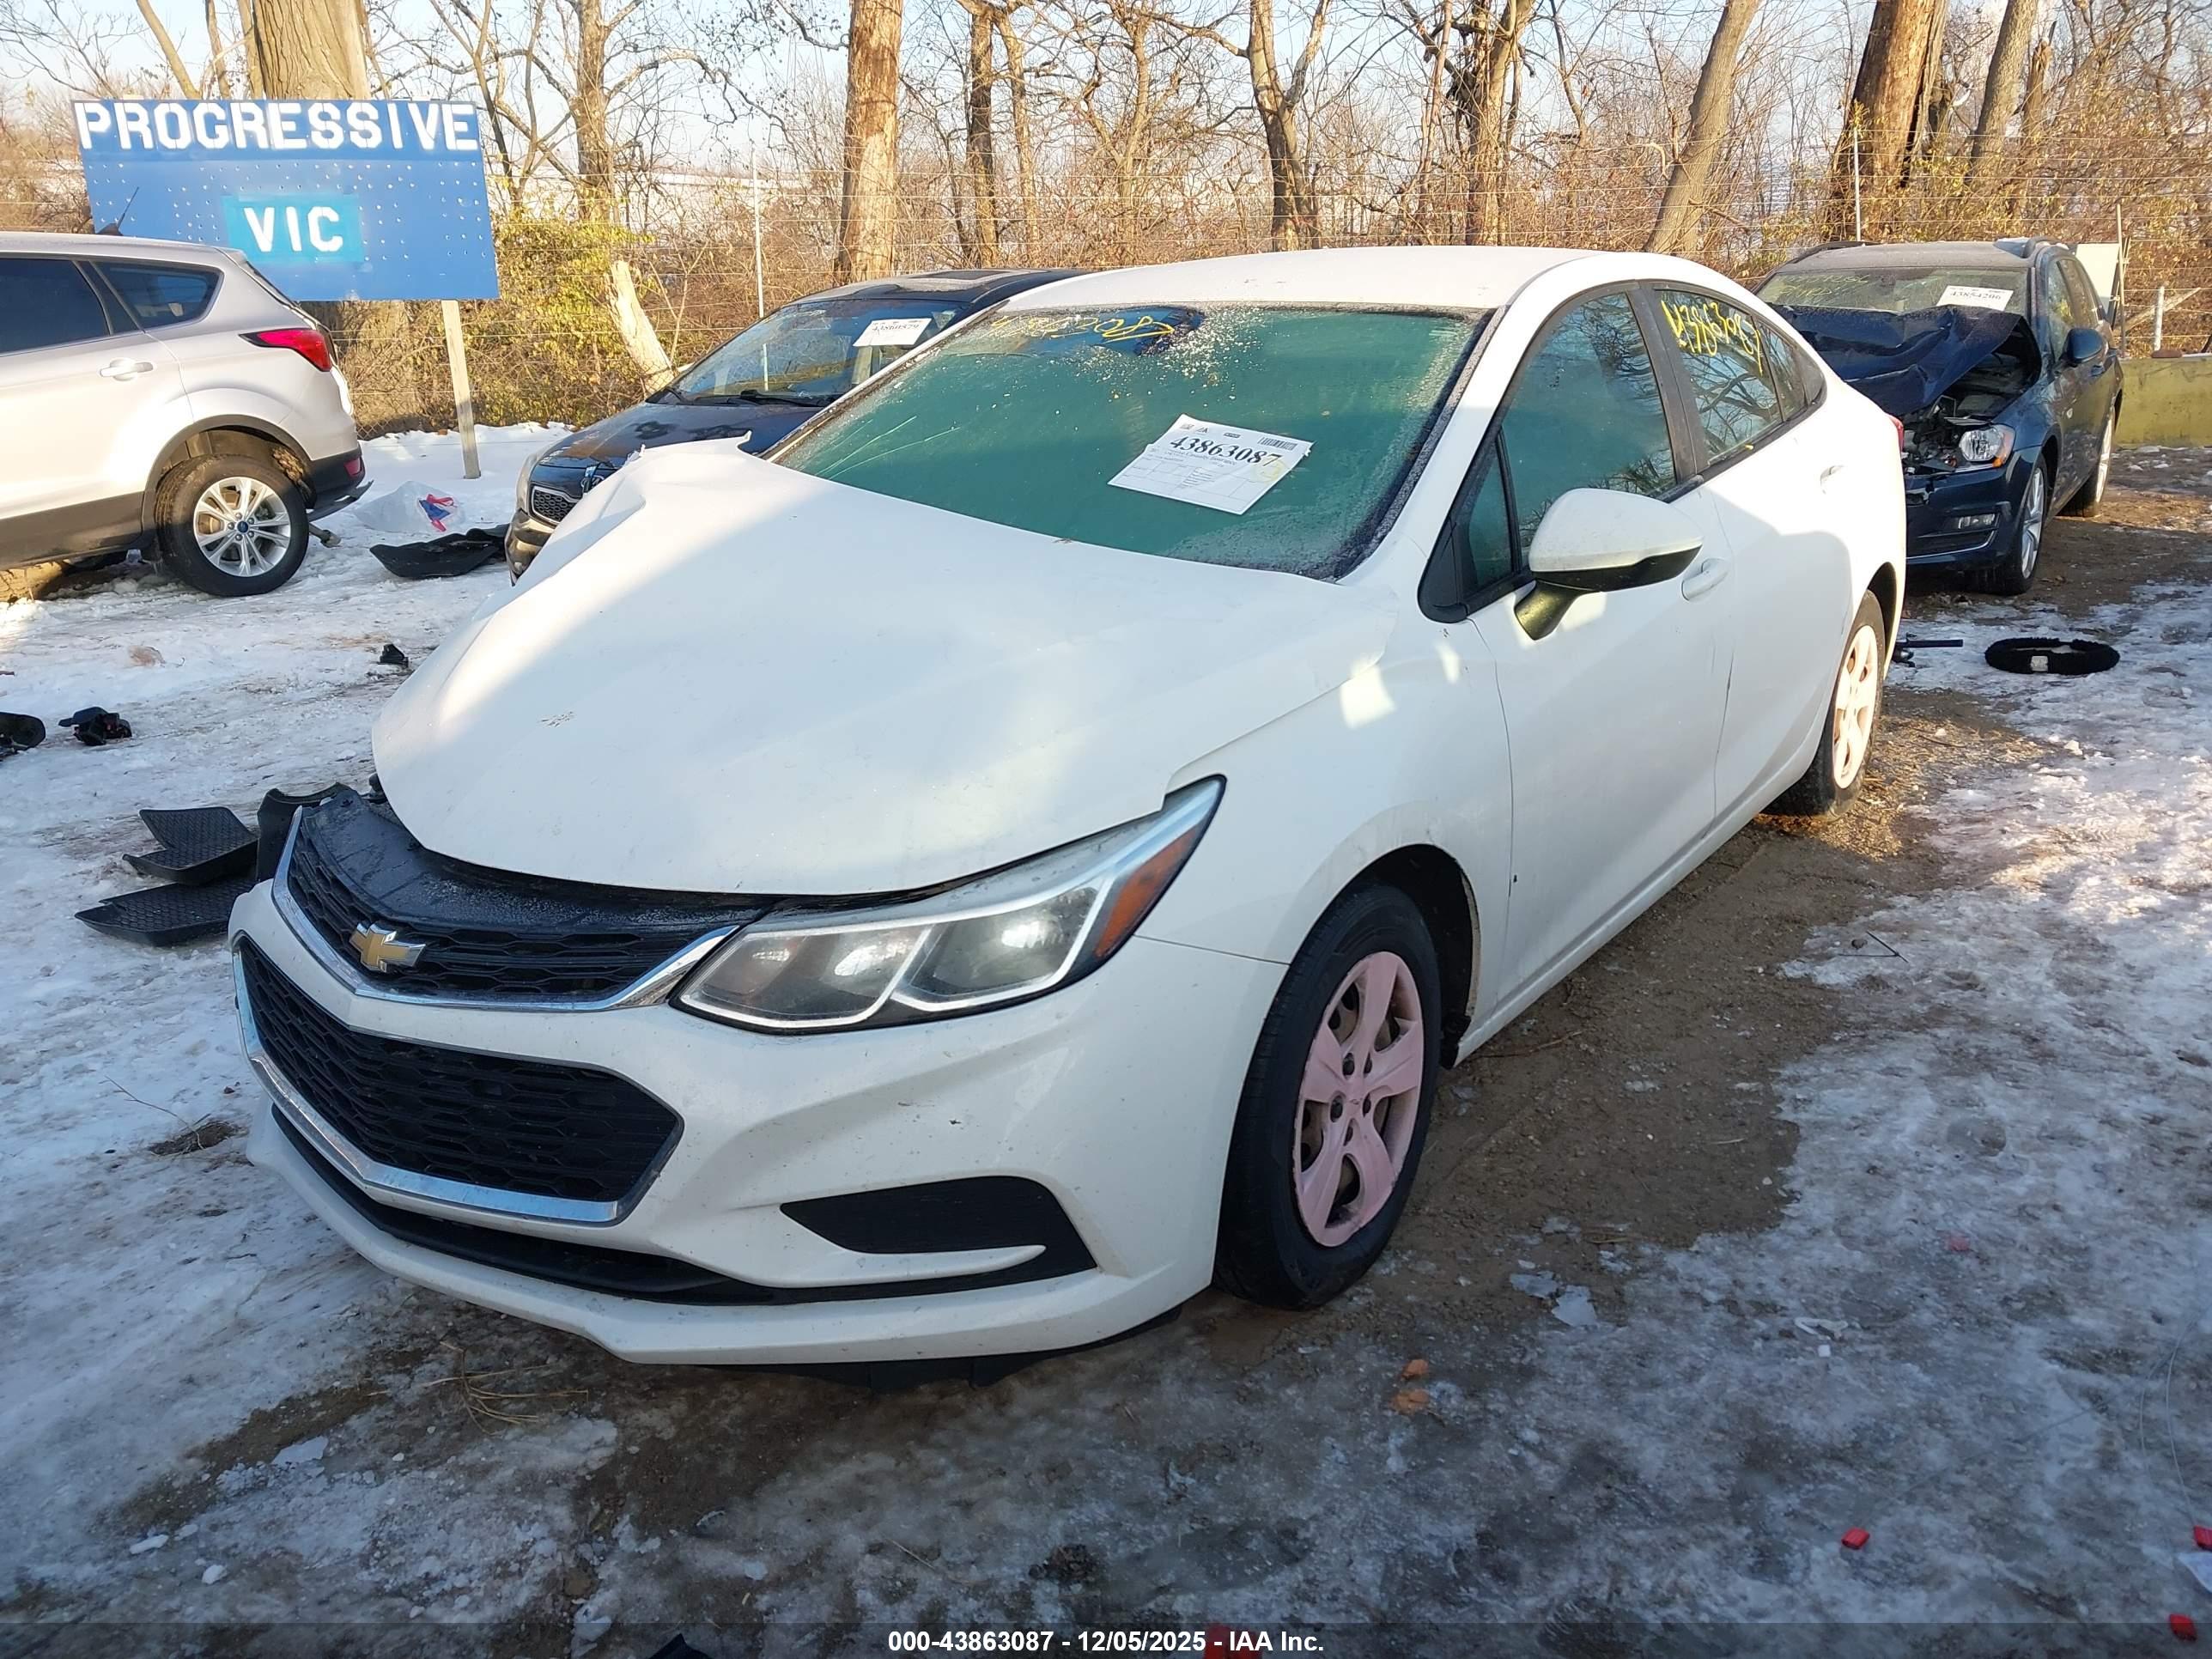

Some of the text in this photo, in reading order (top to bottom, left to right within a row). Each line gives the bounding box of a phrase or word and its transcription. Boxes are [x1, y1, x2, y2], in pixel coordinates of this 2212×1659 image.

[74, 101, 479, 150] PROGRESSIVE
[243, 206, 343, 252] VIC
[1170, 435, 1283, 467] 43863087
